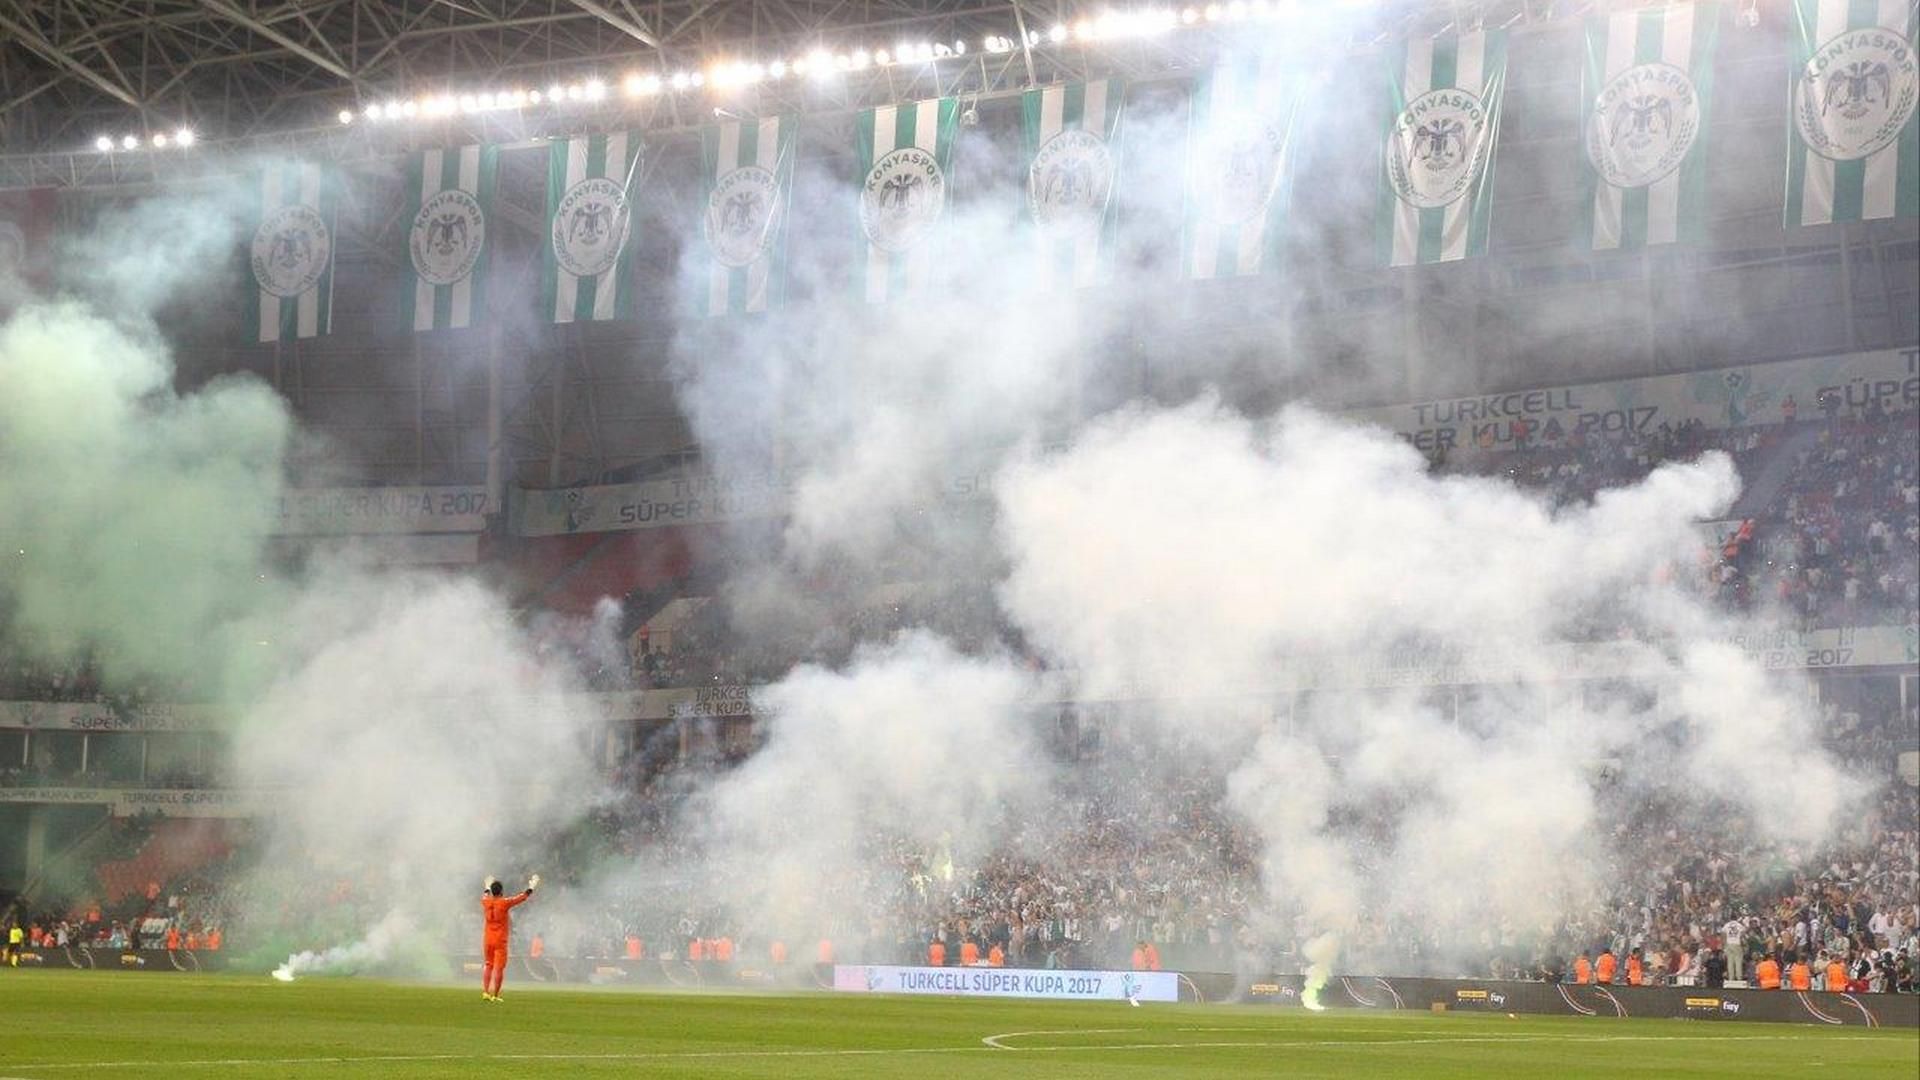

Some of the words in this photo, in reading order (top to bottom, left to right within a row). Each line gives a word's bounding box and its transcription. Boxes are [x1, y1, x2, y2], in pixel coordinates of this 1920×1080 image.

[1806, 33, 1914, 83] KONYASPOR
[1597, 70, 1692, 114] KONYASPOR
[1396, 95, 1484, 137] KONYASPOR
[867, 152, 940, 191] KONYASPOR
[414, 193, 482, 228] KONYASPOR
[559, 181, 628, 216] KONYASPOR
[1413, 388, 1582, 426] TURKCELL
[1815, 377, 1919, 409] SÜPE
[1471, 416, 1565, 445] KUPA
[1577, 406, 1659, 437] 2017
[376, 494, 433, 518] KUPA
[439, 493, 487, 516] 2017
[621, 499, 700, 524] SÜPER
[1807, 648, 1854, 666] 2017
[716, 700, 751, 716] KUPA
[900, 972, 970, 991] TURKCELL
[973, 971, 1020, 992] SÜPER
[1024, 976, 1064, 993] KUPA
[1068, 978, 1102, 994] 2017
